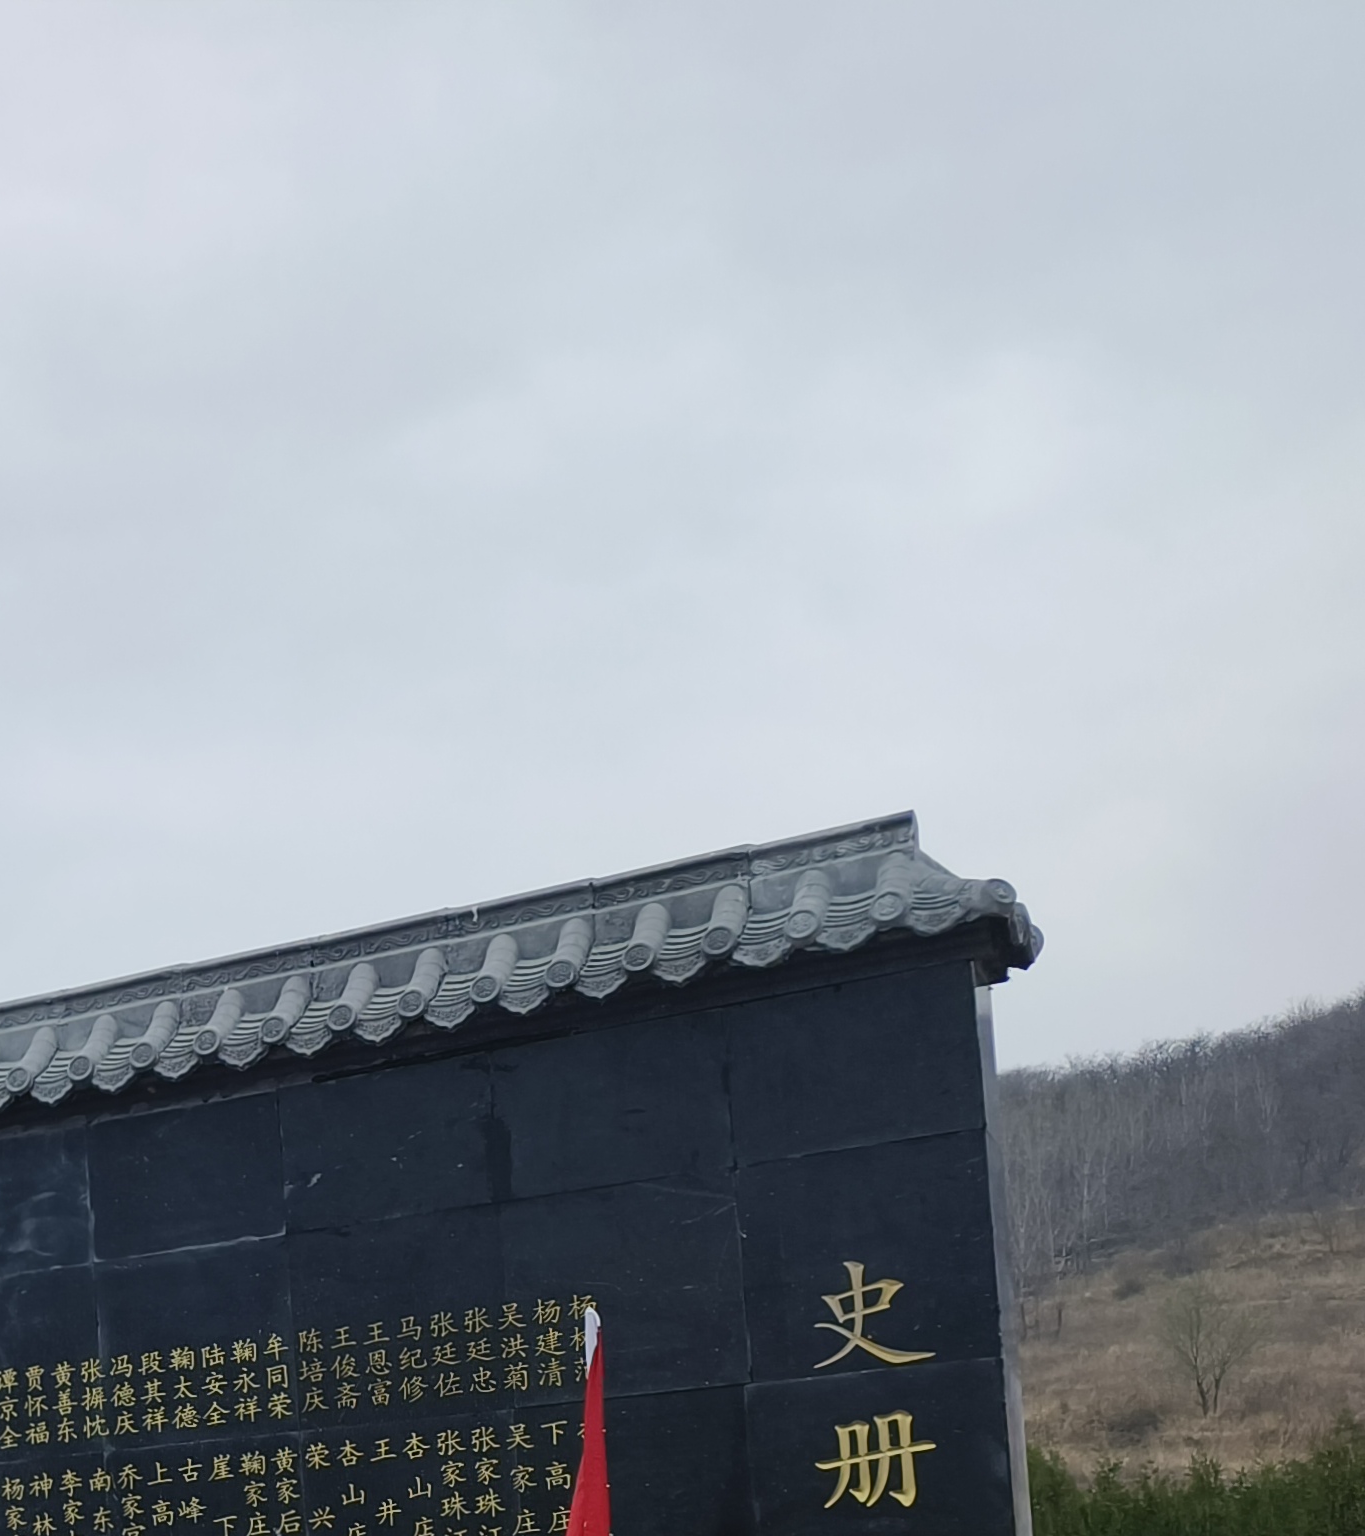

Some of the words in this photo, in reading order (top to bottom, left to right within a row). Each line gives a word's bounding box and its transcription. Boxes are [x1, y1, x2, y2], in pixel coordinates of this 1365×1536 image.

[232, 1338, 259, 1420] 鞠永祥
[265, 1333, 291, 1418] 牟同荣
[299, 1328, 326, 1411] 陈培庆
[331, 1325, 359, 1408] 王俊斋
[365, 1321, 391, 1405] 王恩富
[398, 1315, 427, 1401] 马纪修
[430, 1311, 461, 1396] 张廷佐
[464, 1307, 495, 1393] 张廷忠
[500, 1302, 528, 1390] 吴洪菊
[534, 1299, 564, 1385] 杨建清
[24, 1365, 49, 1443] 贾怀福
[52, 1361, 76, 1442] 黄善东
[110, 1354, 136, 1434] 冯德庆
[140, 1351, 167, 1431] 段其祥
[170, 1346, 197, 1428] 鞠太德
[201, 1343, 227, 1425] 陆安全
